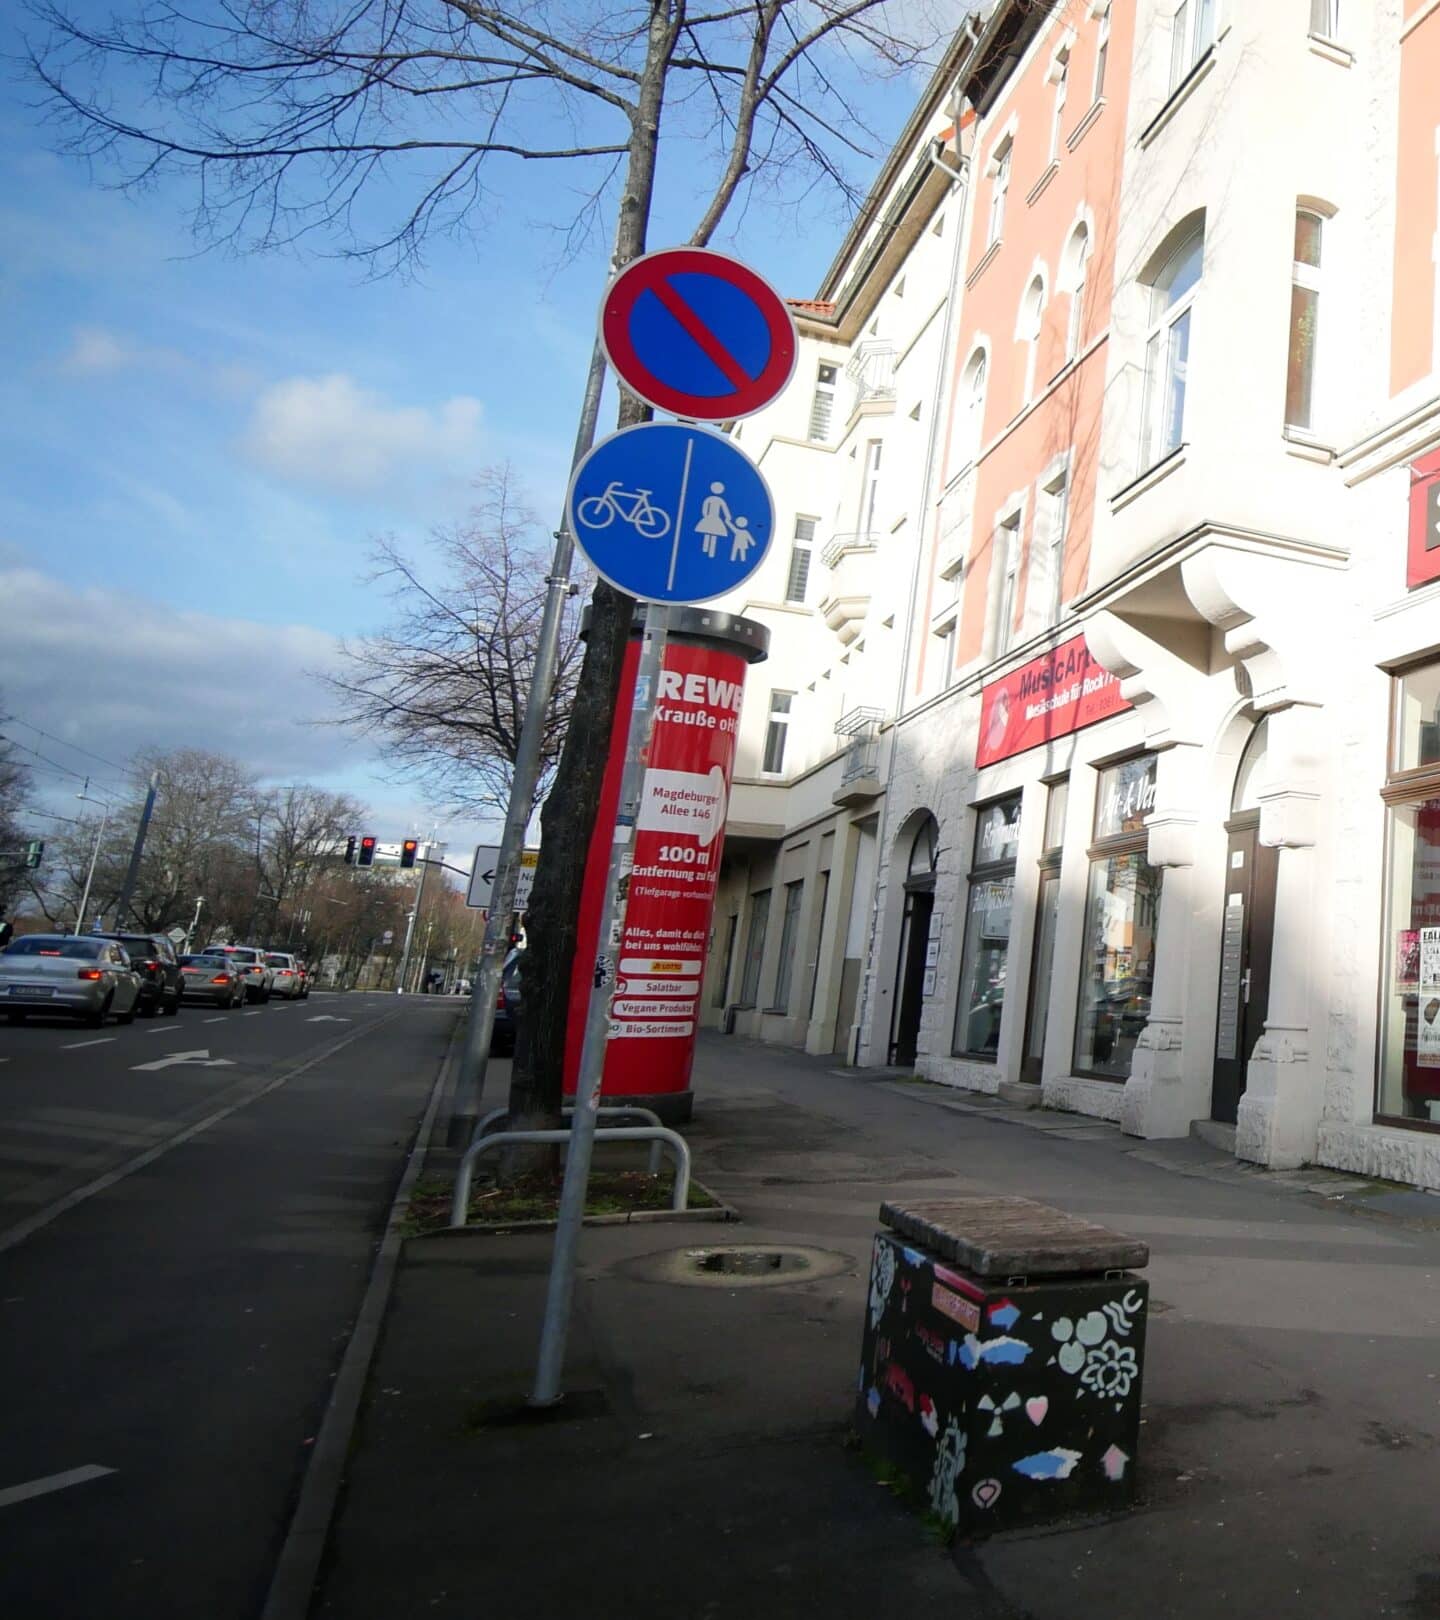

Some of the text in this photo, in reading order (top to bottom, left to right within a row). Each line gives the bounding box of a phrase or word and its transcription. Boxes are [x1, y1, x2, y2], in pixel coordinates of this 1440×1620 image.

[1082, 671, 1104, 697] Rock
[652, 704, 717, 729] Krauße
[652, 787, 720, 806] Magdeburger
[661, 804, 711, 819] Allee 146
[658, 845, 710, 865] 100 m
[632, 864, 695, 881] Entfernung
[625, 927, 655, 938] Alles,
[656, 928, 682, 939] damit
[625, 940, 641, 950] bei
[643, 941, 661, 951] uns
[646, 982, 682, 993] Salatbar
[622, 1003, 657, 1014] Vegane
